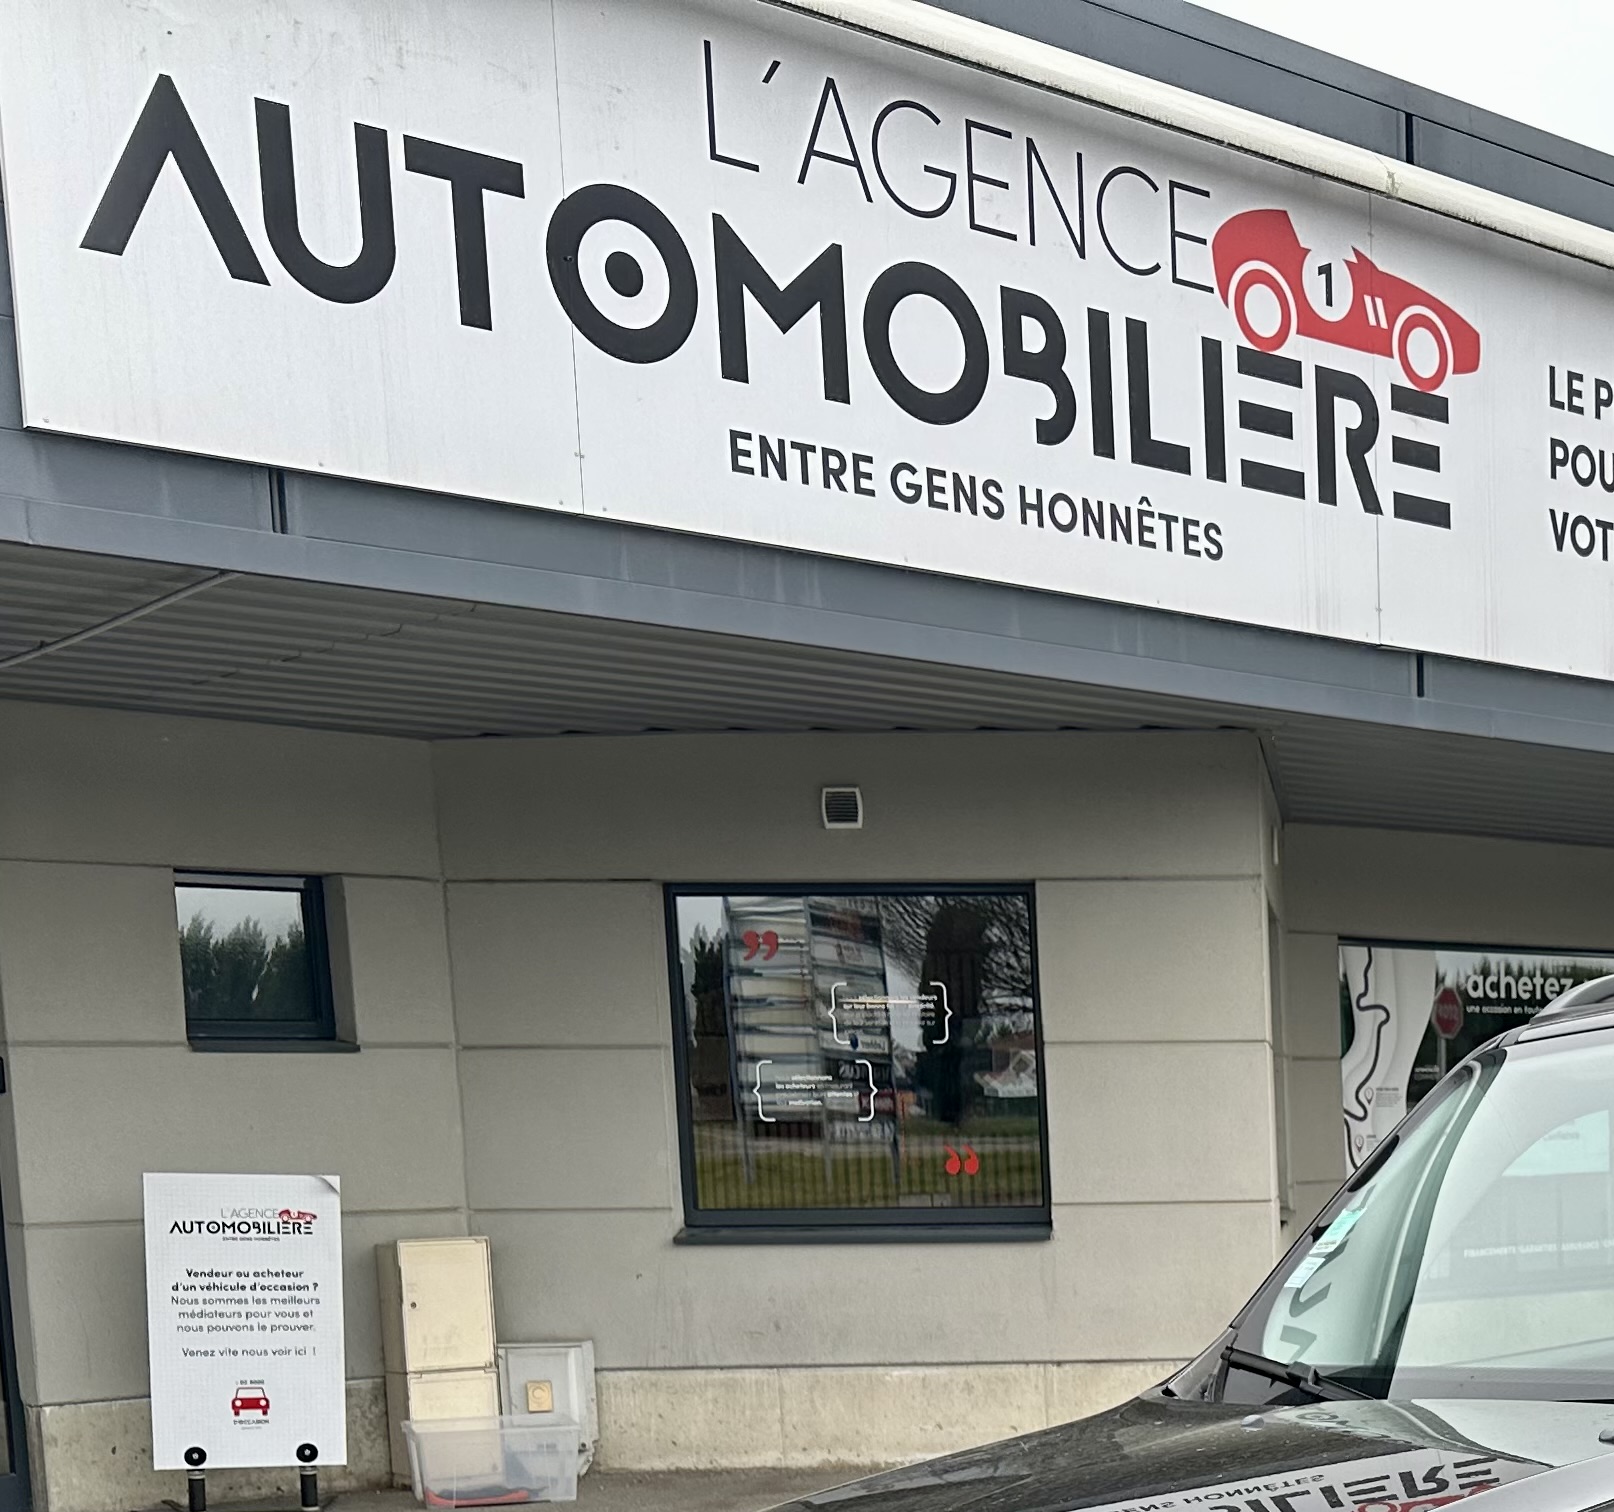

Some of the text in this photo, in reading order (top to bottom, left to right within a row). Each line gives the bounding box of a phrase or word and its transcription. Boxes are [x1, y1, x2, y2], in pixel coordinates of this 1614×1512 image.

[1316, 262, 1335, 308] 1
[1548, 365, 1584, 411] LE
[729, 429, 1225, 561] ENTRE GENS HONNÊTES
[186, 1268, 304, 1278] Vendeur ou acheteur
[171, 1281, 319, 1292] d'un véhicule d'occasion ?
[171, 1295, 321, 1305] Nous sommes les meilleurs
[178, 1309, 314, 1320] médiateurs pour vous et
[176, 1324, 204, 1333] nous
[207, 1324, 254, 1334] pouvons
[257, 1322, 267, 1332] le
[182, 1347, 215, 1357] Venez
[218, 1347, 238, 1357] vite
[241, 1348, 269, 1357] nous
[271, 1346, 292, 1356] voir
[294, 1346, 307, 1356] ici
